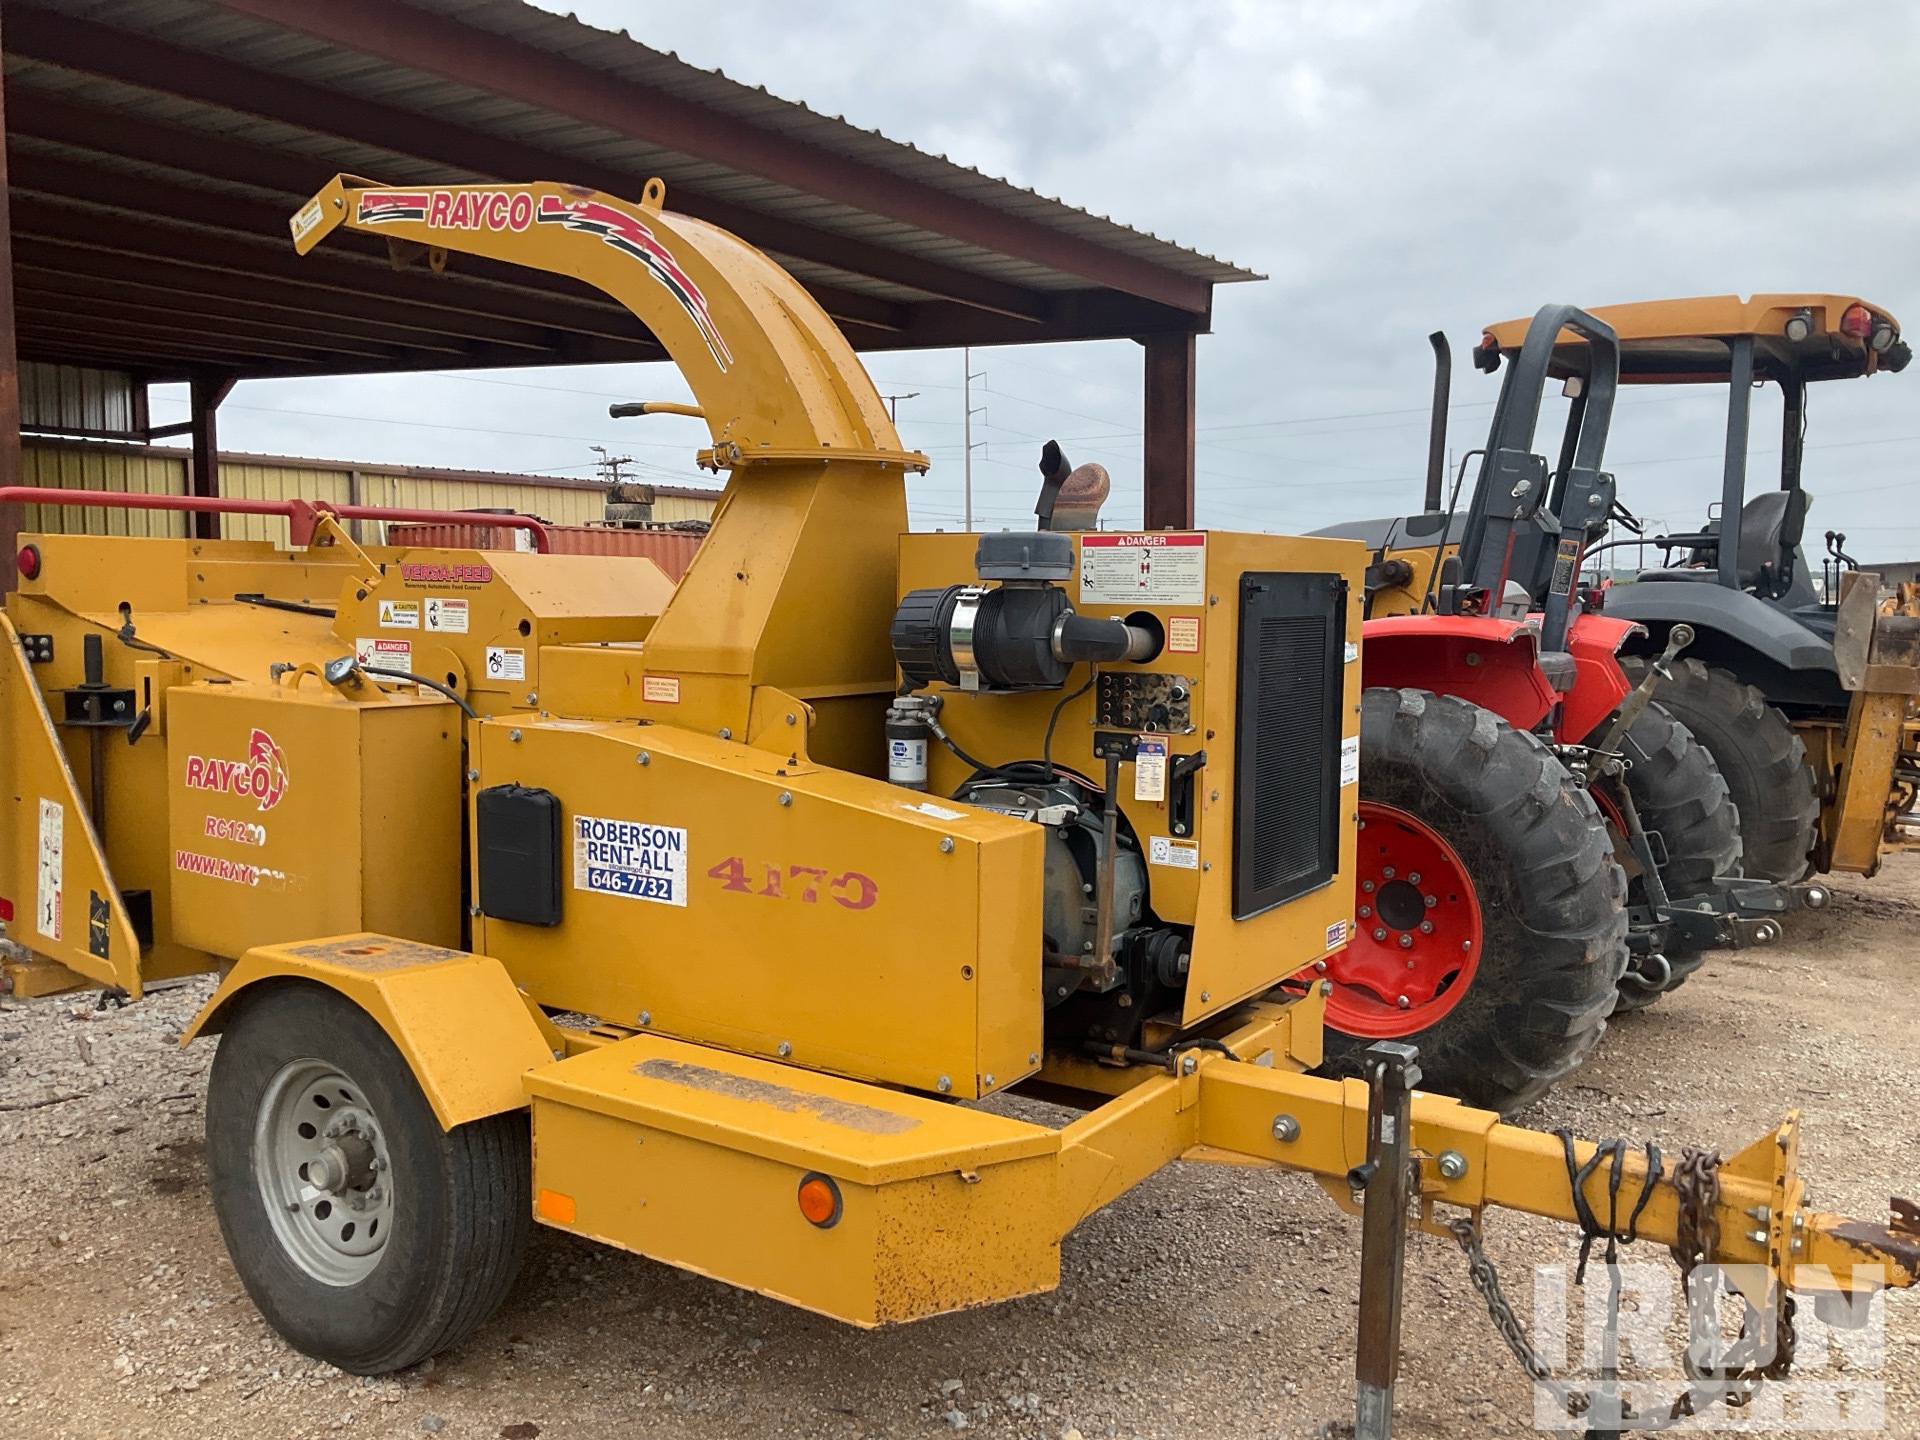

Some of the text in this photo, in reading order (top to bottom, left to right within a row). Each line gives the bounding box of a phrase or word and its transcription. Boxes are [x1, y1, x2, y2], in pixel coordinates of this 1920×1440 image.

[428, 190, 533, 232] RAYCO
[1126, 536, 1167, 546] DANGER
[400, 563, 492, 583] VERSA-FEED
[404, 582, 427, 590] Reversing
[382, 643, 408, 651] DANGER
[186, 756, 271, 800] RAYCO
[581, 819, 681, 852] ROBERSON
[588, 841, 674, 872] RENT-ALL
[591, 869, 669, 898] 646-7732
